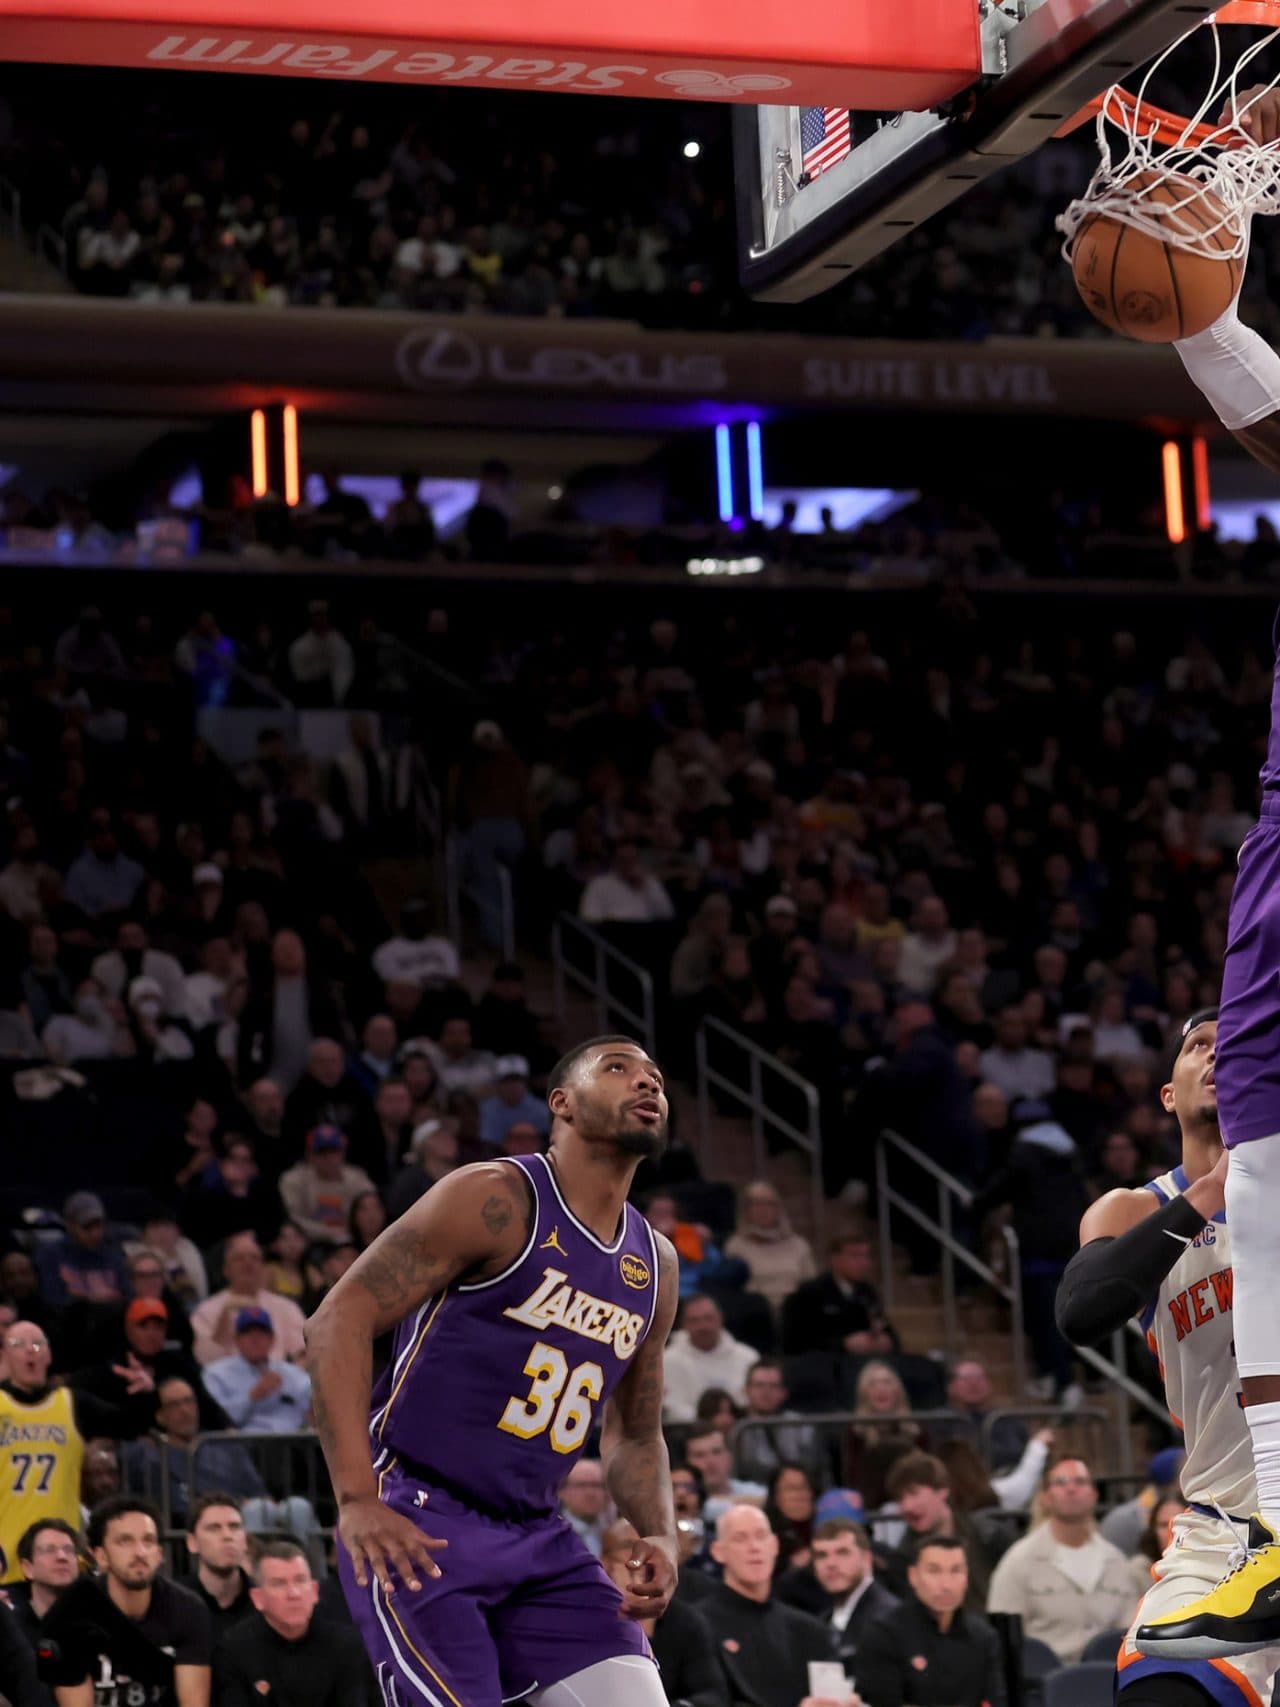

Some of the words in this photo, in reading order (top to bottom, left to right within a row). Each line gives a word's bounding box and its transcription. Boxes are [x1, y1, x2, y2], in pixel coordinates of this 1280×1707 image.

[490, 351, 727, 391] LEXUS
[802, 357, 922, 398] SUITE
[933, 361, 1056, 404] LEVEL
[502, 1267, 645, 1361] LAKERS
[1167, 1267, 1234, 1343] NEW
[496, 1341, 605, 1455] 36
[11, 1452, 57, 1492] 77
